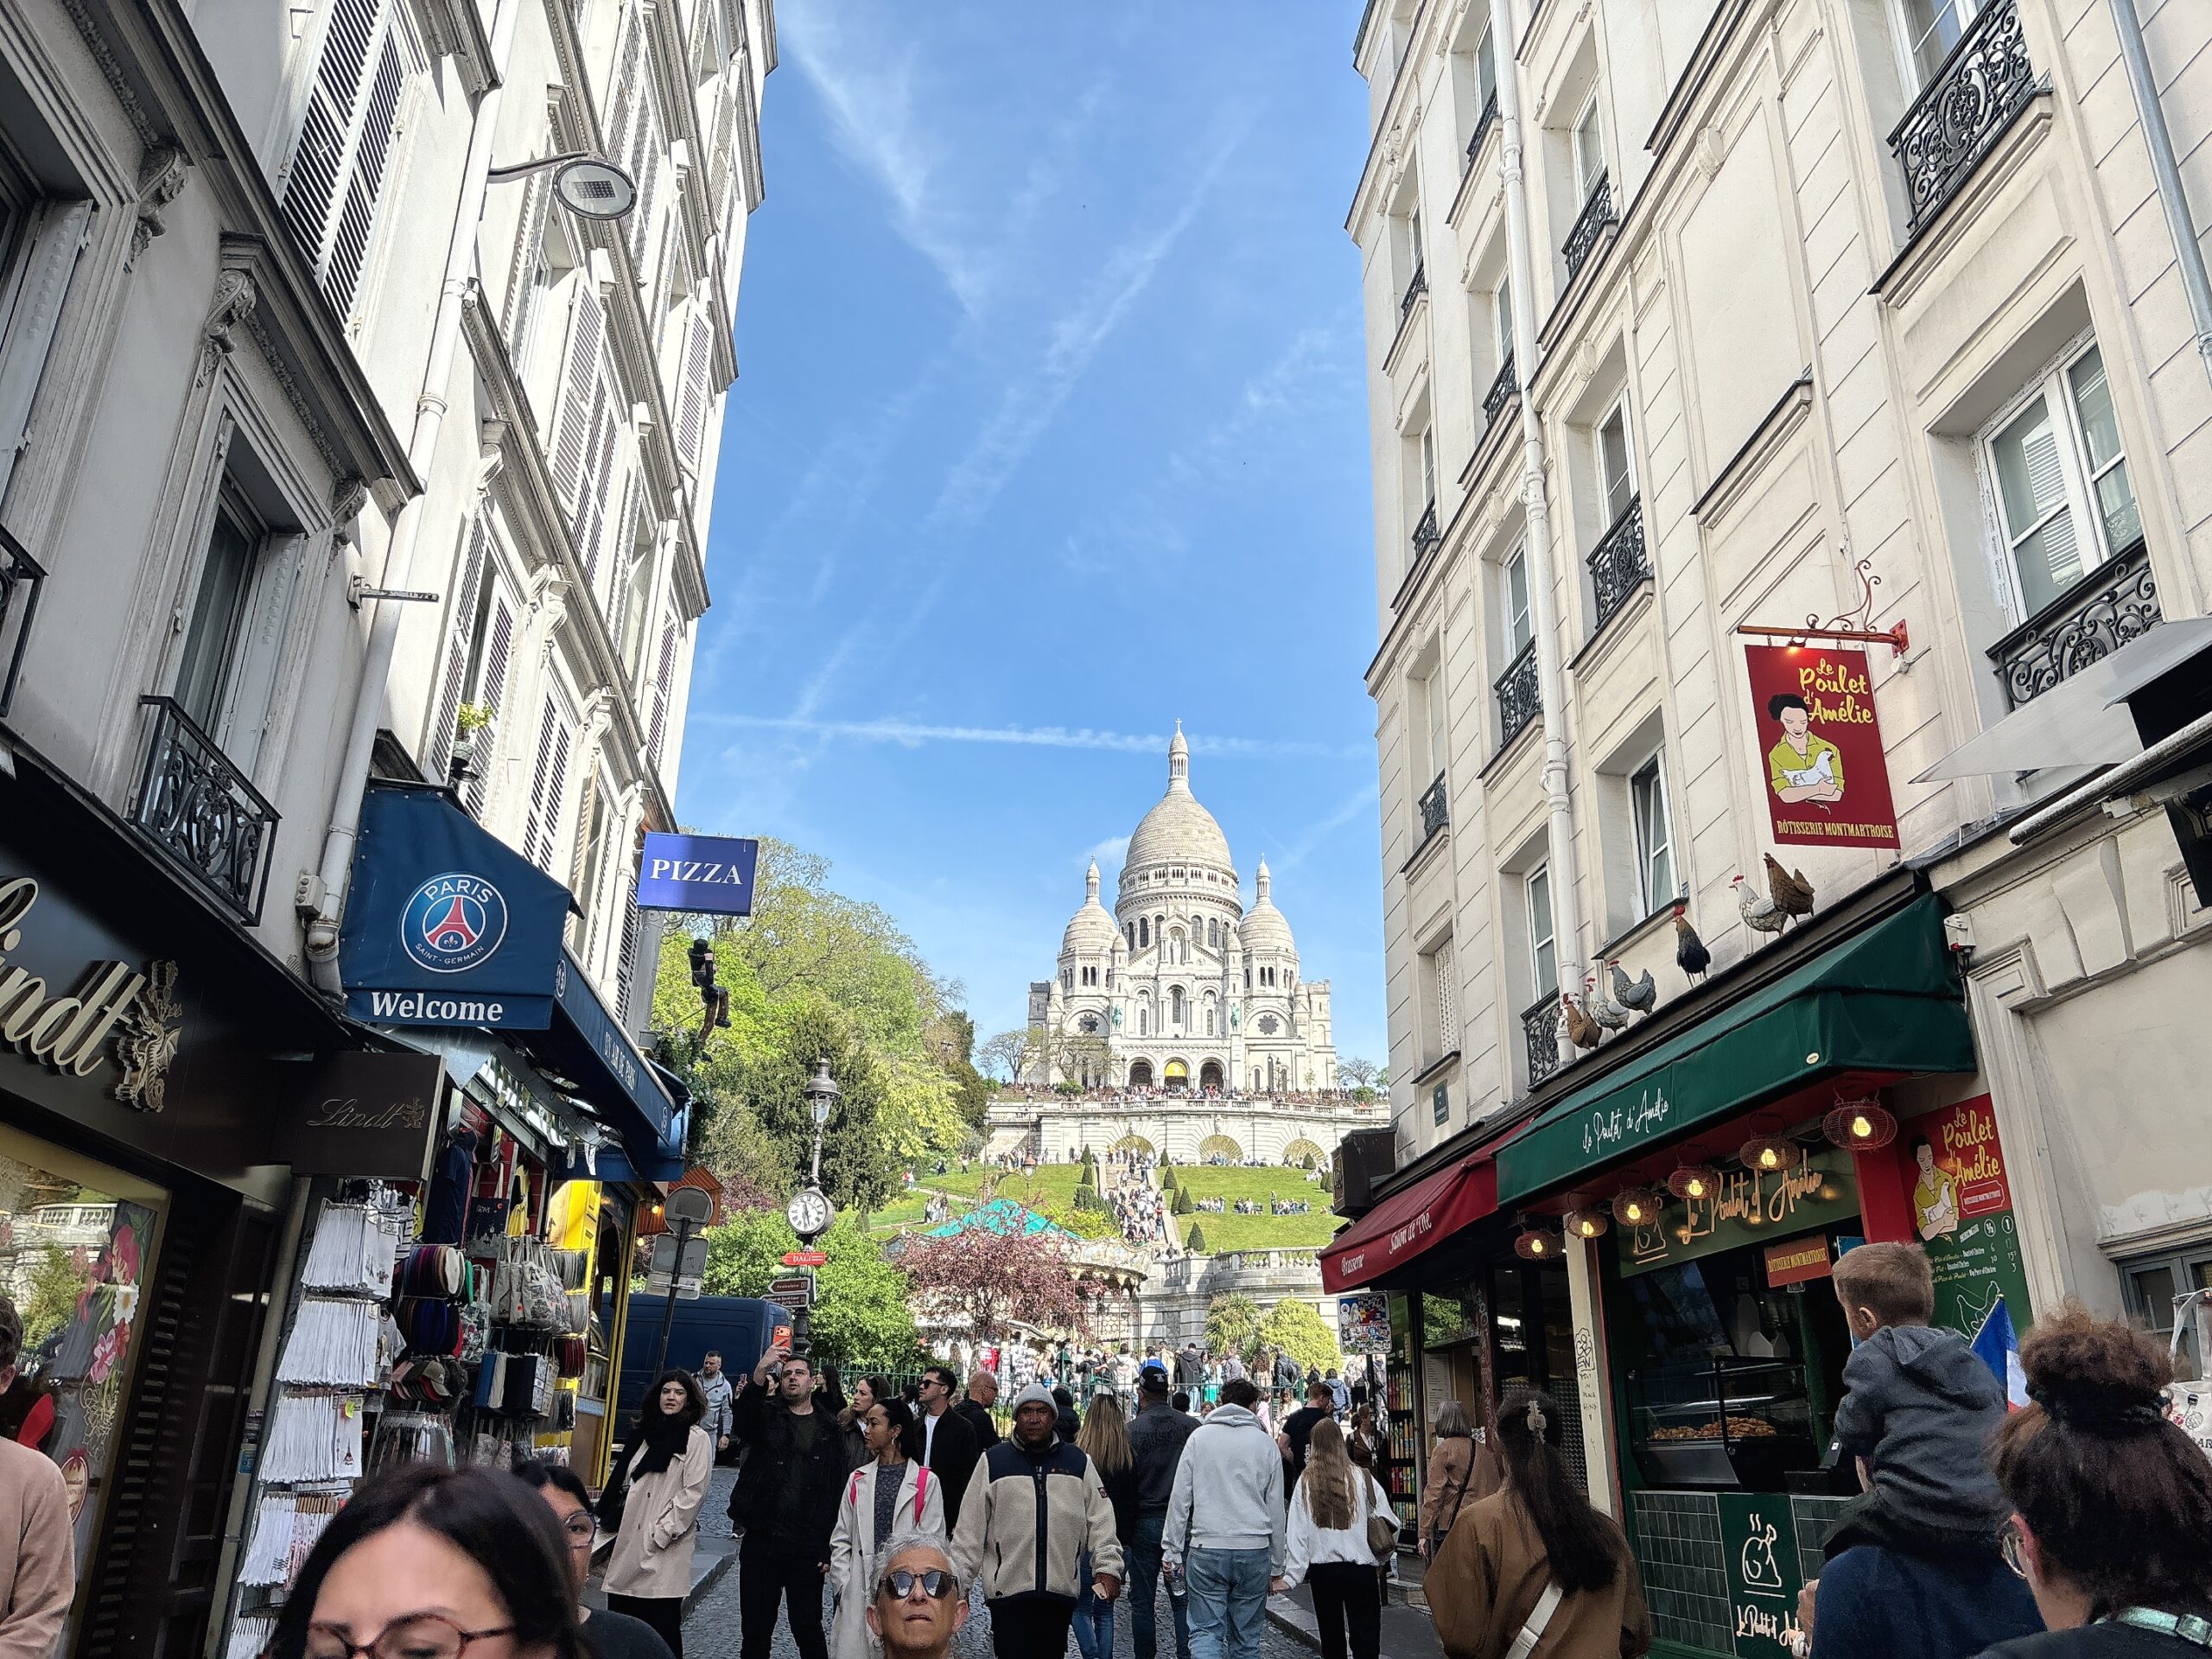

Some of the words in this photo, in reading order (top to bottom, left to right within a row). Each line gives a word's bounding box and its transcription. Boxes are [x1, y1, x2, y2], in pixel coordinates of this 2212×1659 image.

[1799, 664, 1869, 695] Poulet
[1816, 658, 1834, 676] Le
[1808, 695, 1874, 724] Amélie
[1824, 822, 1894, 839] MONTMARTROISE
[650, 859, 743, 886] PIZZA
[423, 879, 493, 904] PARIS
[372, 992, 503, 1022] Welcome
[306, 1098, 405, 1128] Lindt
[1954, 1107, 1967, 1128] Le
[1593, 1108, 1623, 1154] Poulet
[1942, 1109, 1994, 1152] Poulet
[1954, 1144, 2001, 1187] Amélie
